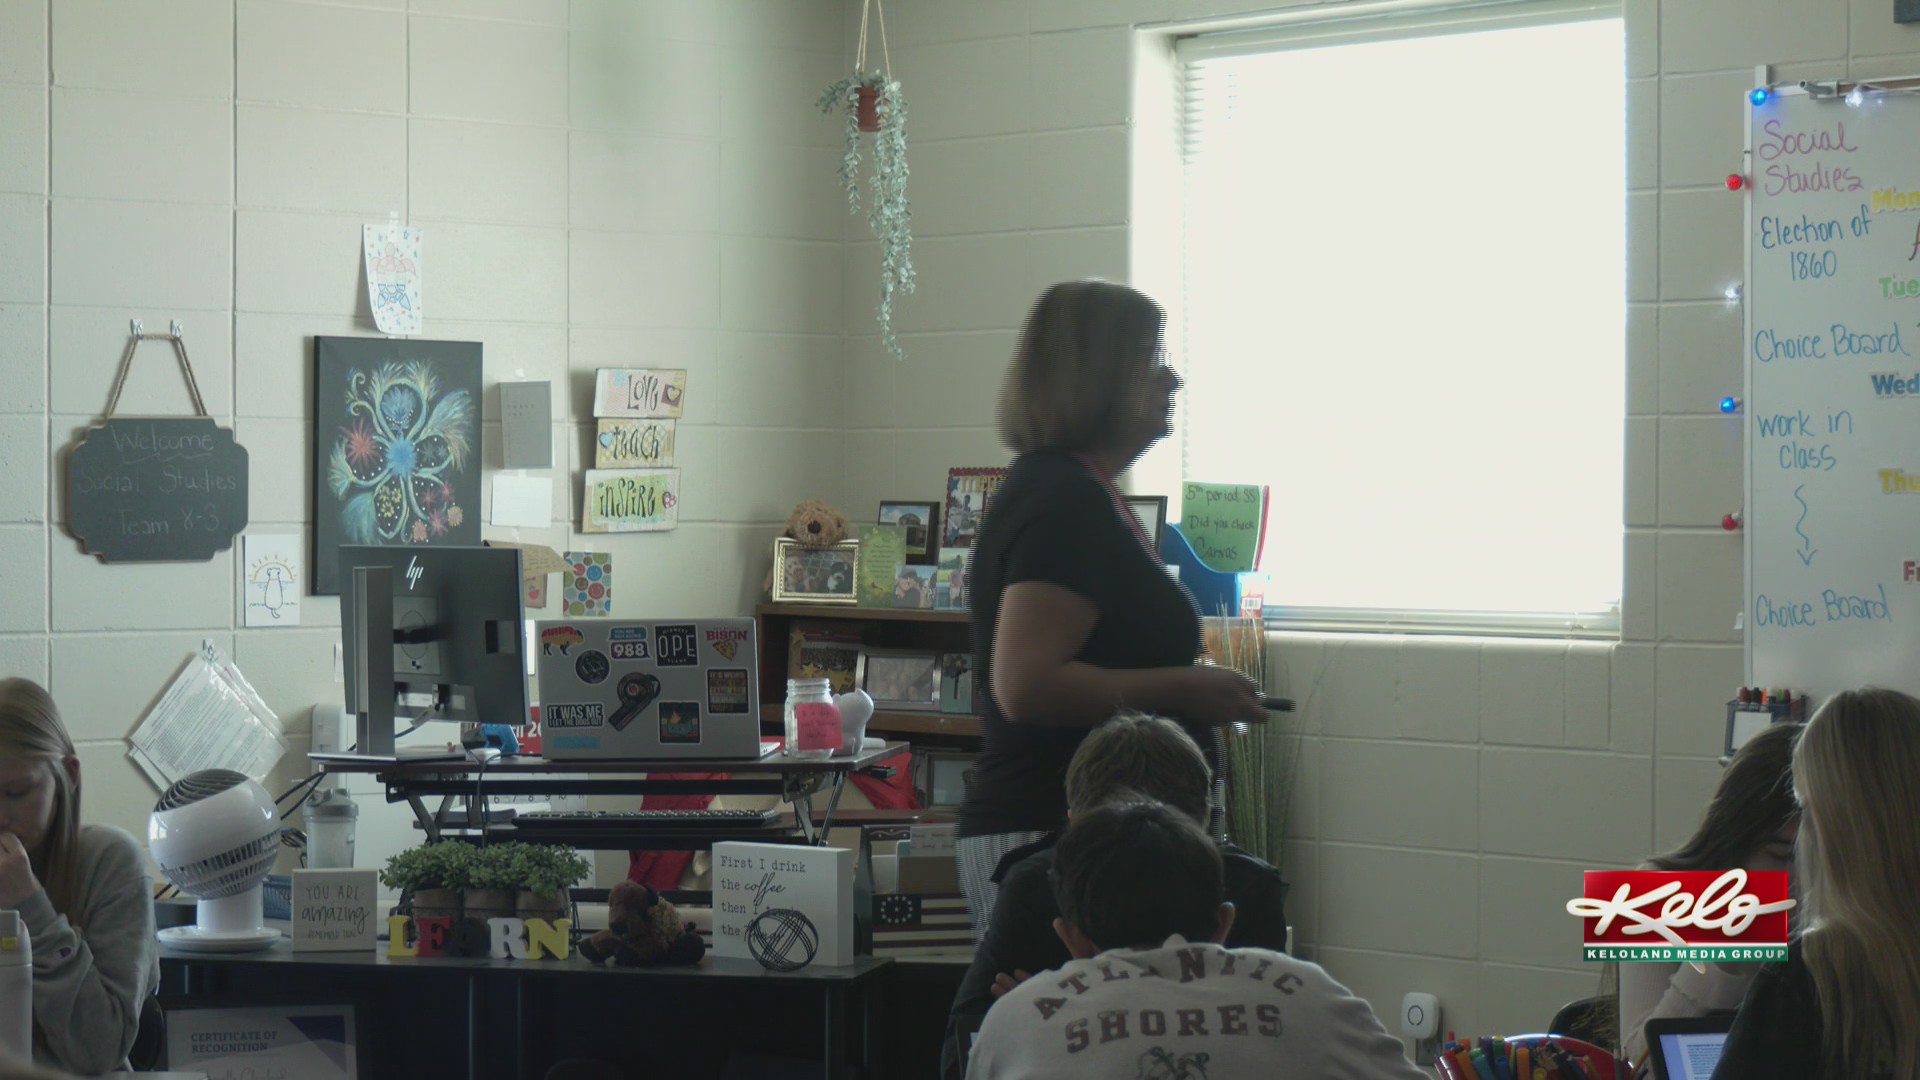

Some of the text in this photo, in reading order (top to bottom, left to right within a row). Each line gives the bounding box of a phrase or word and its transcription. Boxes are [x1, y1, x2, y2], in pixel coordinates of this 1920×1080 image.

[1759, 119, 1858, 160] Social
[1764, 162, 1863, 196] Studies
[1760, 204, 1872, 249] Election of
[1790, 250, 1837, 281] 1860
[1754, 322, 1911, 361] Choice Board
[1871, 373, 1920, 396] Wed
[1757, 405, 1853, 438] work in
[111, 424, 214, 452] Welcome
[77, 465, 237, 493] Social Studies
[1206, 486, 1239, 506] period
[116, 508, 169, 535] Team
[1189, 514, 1209, 529] Did
[1755, 583, 1893, 628] Choice Board
[658, 634, 697, 658] OPE
[705, 630, 748, 641] BISON
[613, 643, 645, 657] 988
[548, 705, 602, 719] IT WAS ME
[721, 855, 807, 873] First I drink
[305, 885, 329, 900] YOU
[720, 871, 786, 906] the coffee
[301, 906, 370, 935] amazing
[721, 902, 747, 914] then
[721, 924, 741, 936] the
[1033, 948, 1304, 1020] ATLNTIC
[191, 1030, 278, 1042] CERTIFICATE OF
[1065, 1004, 1282, 1053] SHORES
[191, 1042, 268, 1053] RECOGNITION
